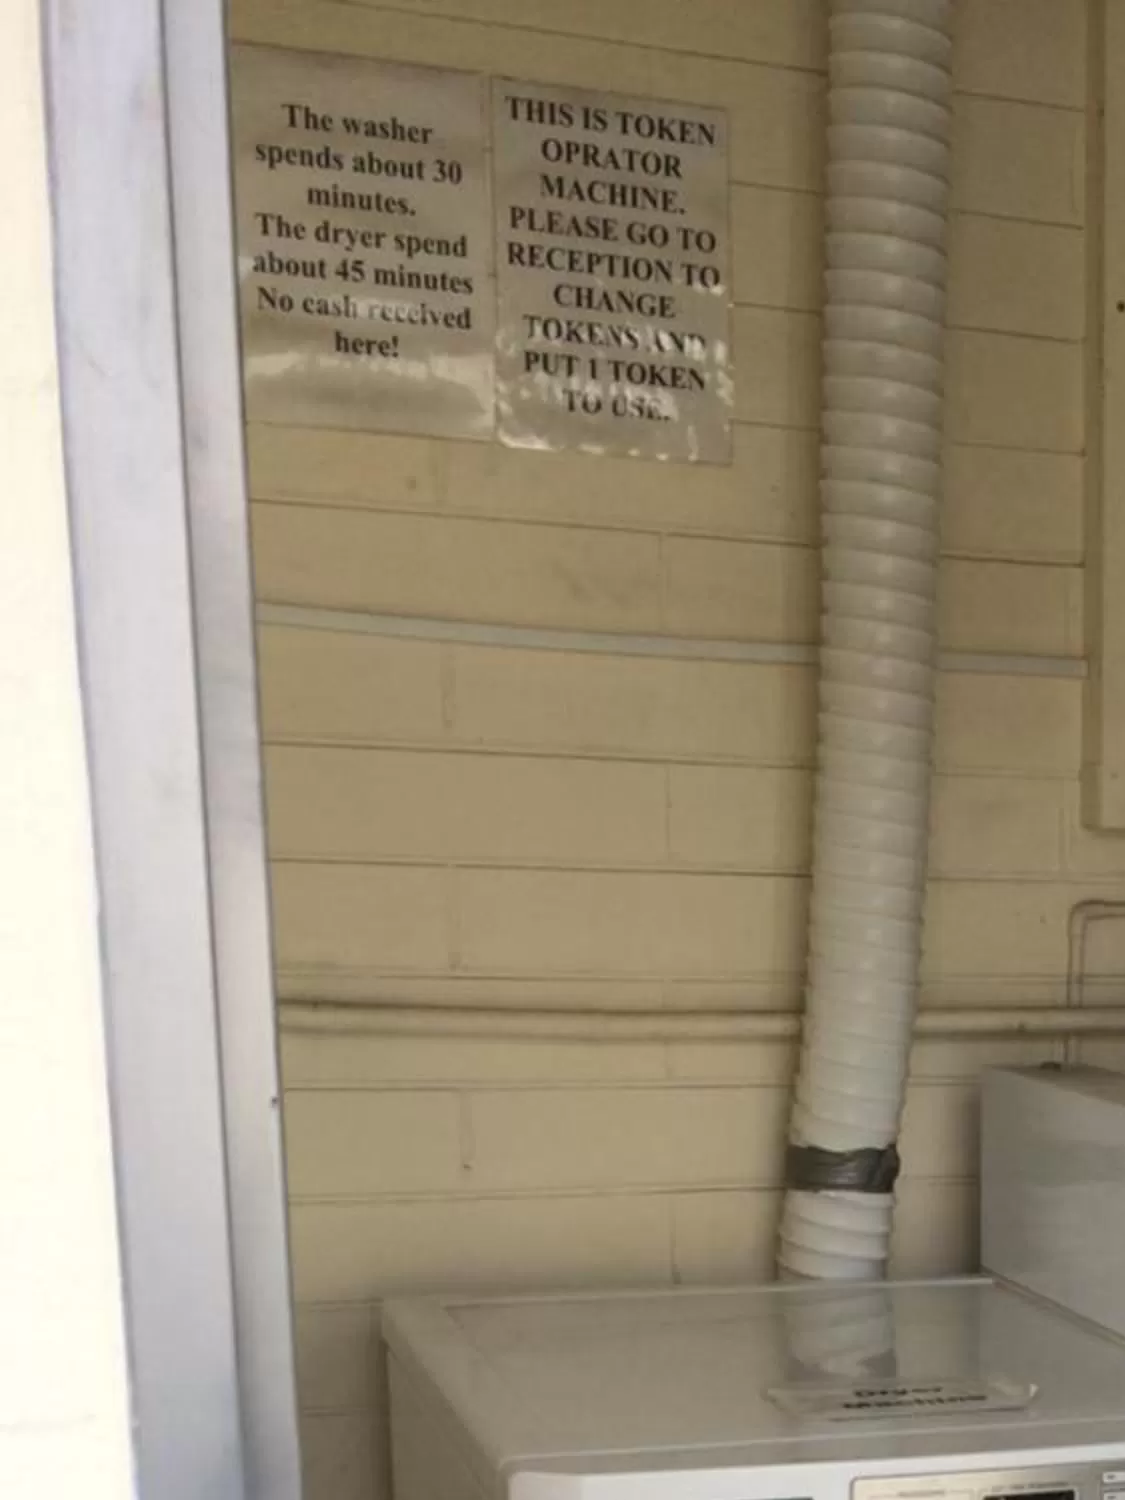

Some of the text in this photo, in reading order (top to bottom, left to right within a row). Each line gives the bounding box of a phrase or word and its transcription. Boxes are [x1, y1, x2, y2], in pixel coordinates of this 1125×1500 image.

[281, 104, 433, 145] The washer
[505, 96, 715, 145] THIS IS TOKEN
[255, 143, 462, 185] spends about 30
[541, 138, 682, 179] OPRATOR
[307, 184, 416, 217] minutes.
[540, 173, 685, 215] MACHINE.
[254, 212, 468, 259] The dryer spend
[509, 205, 716, 254] PLEASE GO TO
[252, 252, 474, 296] about 45 minutes
[507, 241, 721, 289] RECEPTION TO
[256, 286, 472, 331] No cash received
[553, 283, 676, 319] CHANGE
[334, 329, 399, 358] here!
[522, 314, 639, 349] TOKENS
[524, 351, 580, 377] PUT
[608, 359, 705, 391] TOKEN
[563, 388, 601, 414] TO
